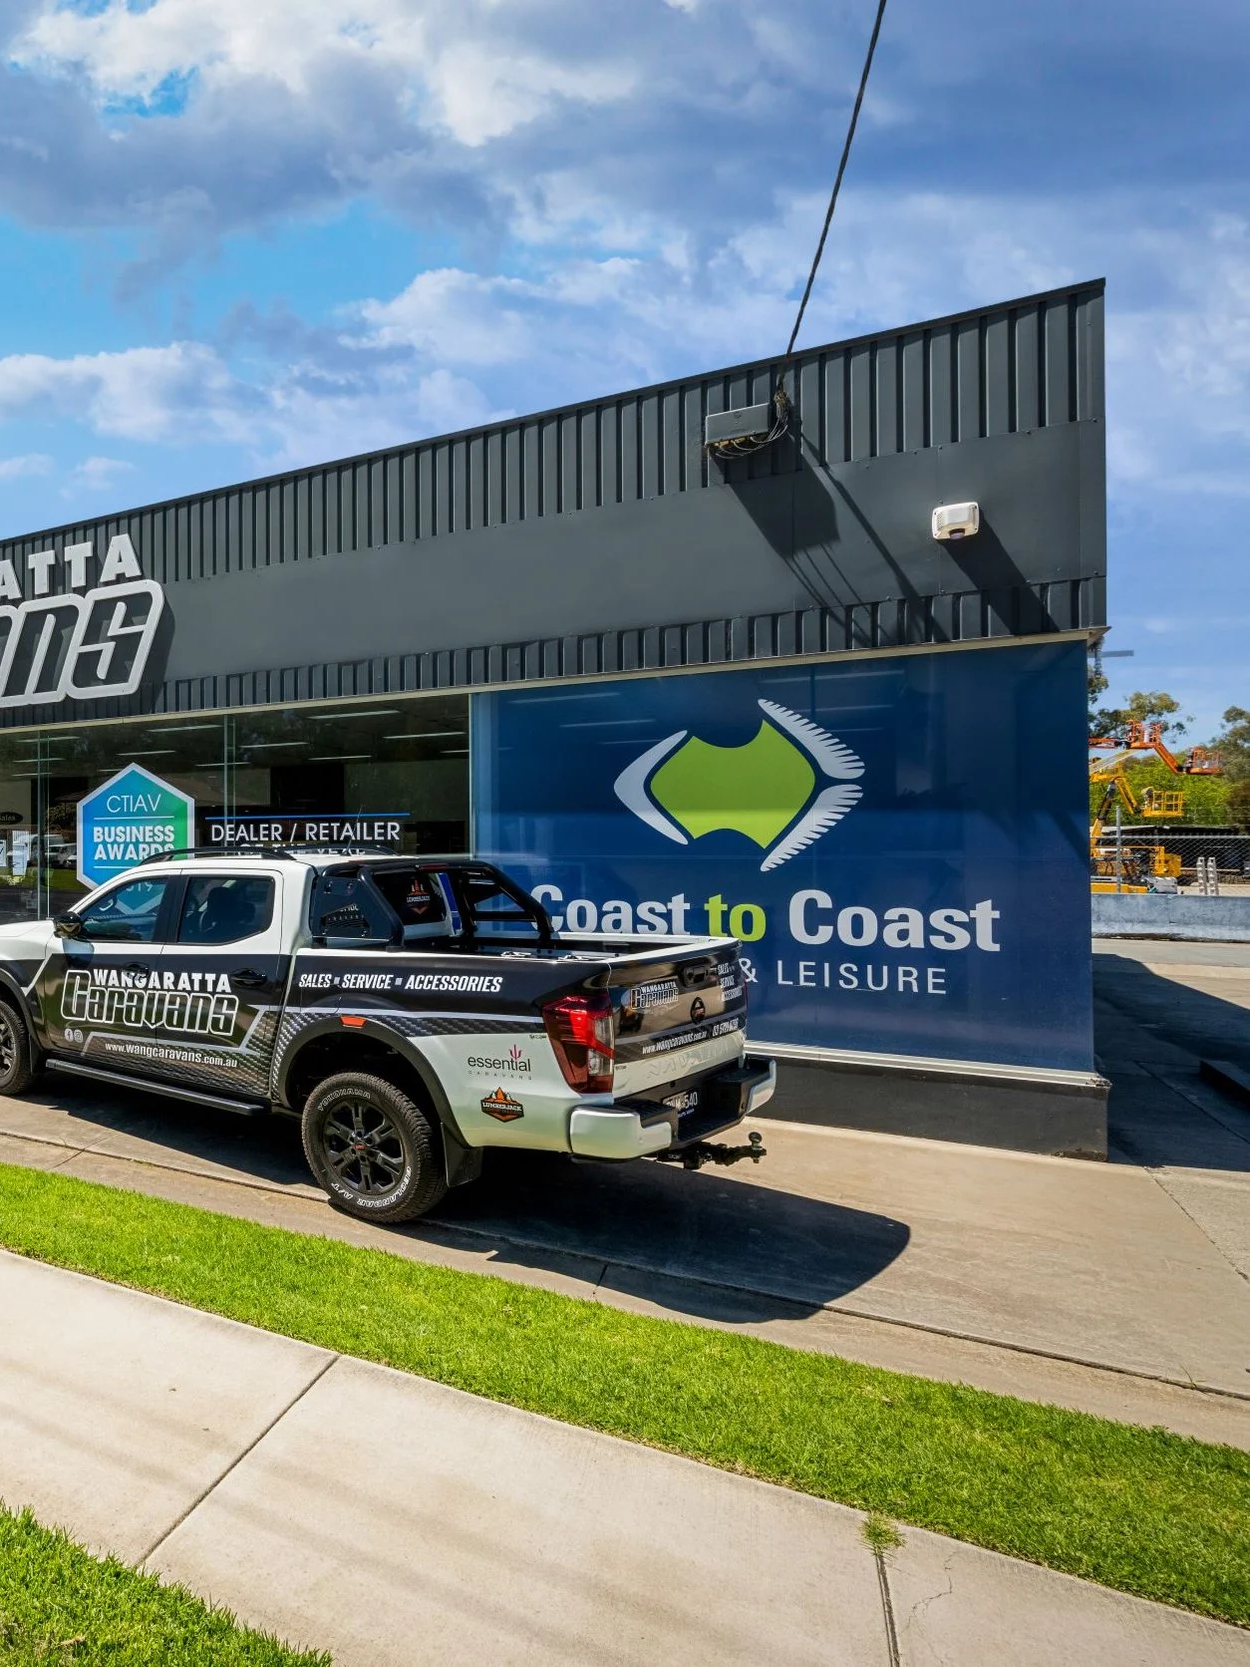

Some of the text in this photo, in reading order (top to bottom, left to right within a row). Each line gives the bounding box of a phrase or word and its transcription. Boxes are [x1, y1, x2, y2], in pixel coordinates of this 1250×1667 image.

[106, 793, 162, 813] CTIAV
[93, 825, 175, 843] BUSINESS
[211, 822, 400, 842] DEALER / RETAILER
[530, 884, 1000, 952] Coast to Coast
[93, 968, 232, 993] WANGARATTA
[298, 973, 503, 993] SALES SERVICE ACCESSORIES
[738, 958, 947, 995] & LEISURE
[640, 981, 677, 993] WANGARATTA
[60, 969, 240, 1036] Caravans
[105, 1043, 238, 1068] www.wangcaravans.com.au
[467, 1055, 531, 1072] essential
